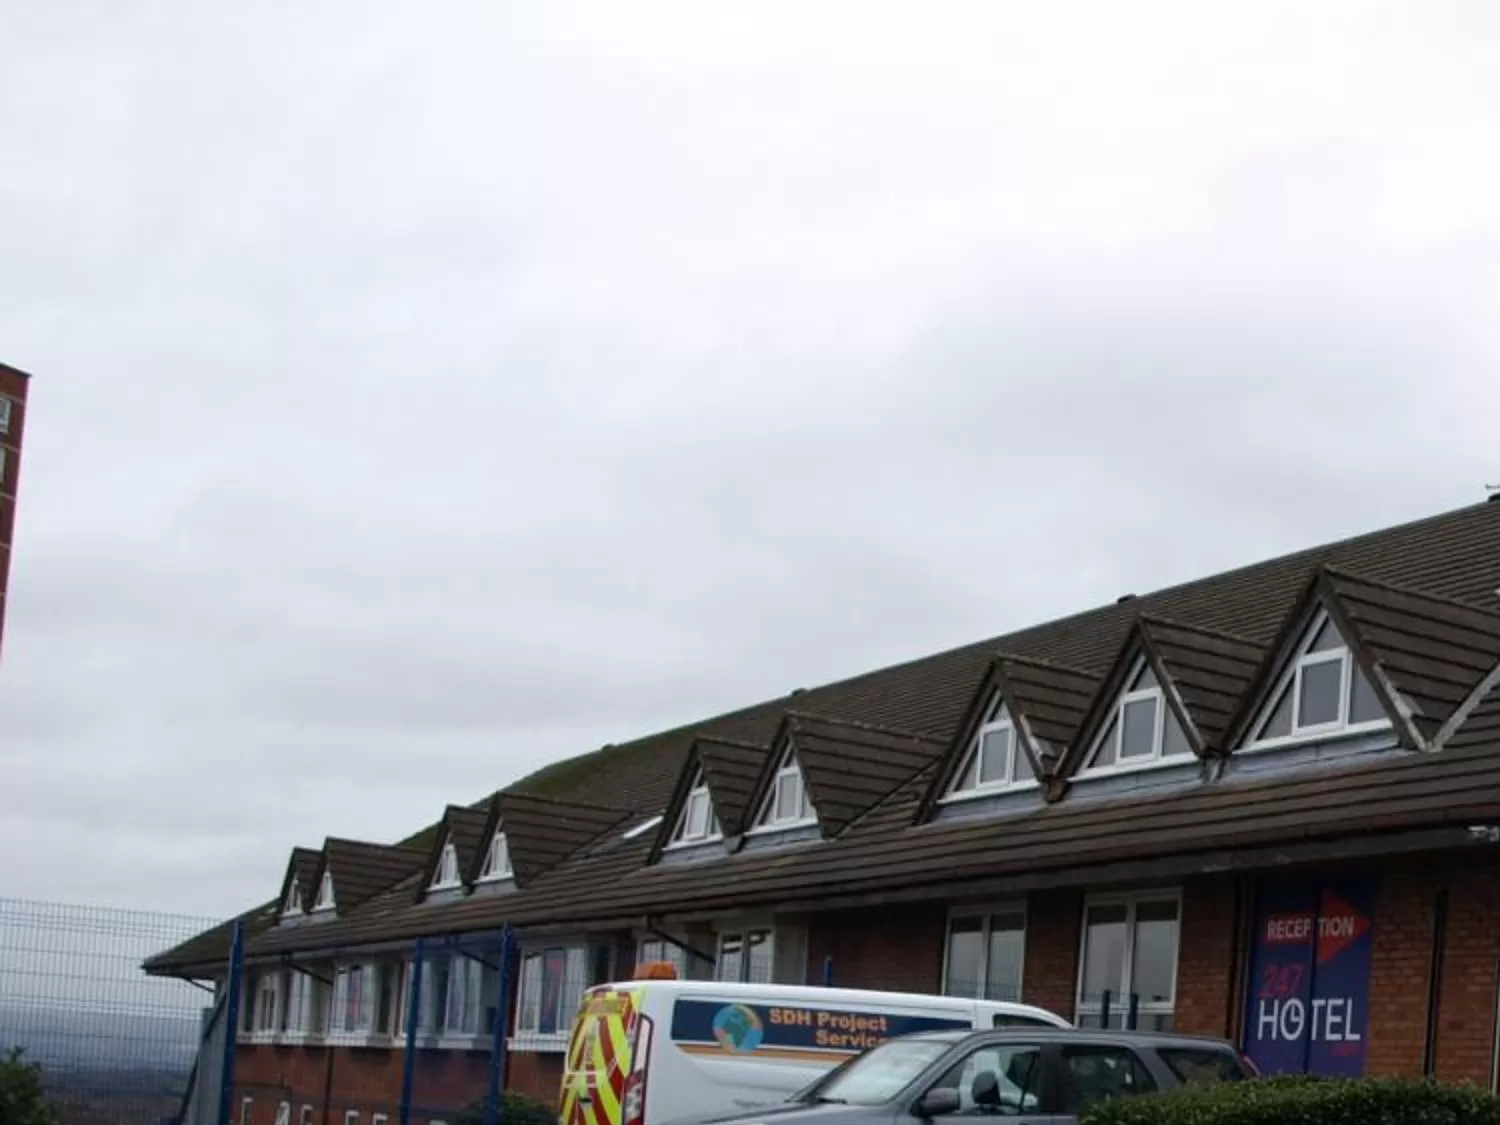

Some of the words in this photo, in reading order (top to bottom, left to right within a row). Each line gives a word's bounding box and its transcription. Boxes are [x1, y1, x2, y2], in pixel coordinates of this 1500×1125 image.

[770, 1008, 811, 1025] SDH
[818, 1012, 887, 1031] Project
[1257, 997, 1361, 1041] HOTEL
